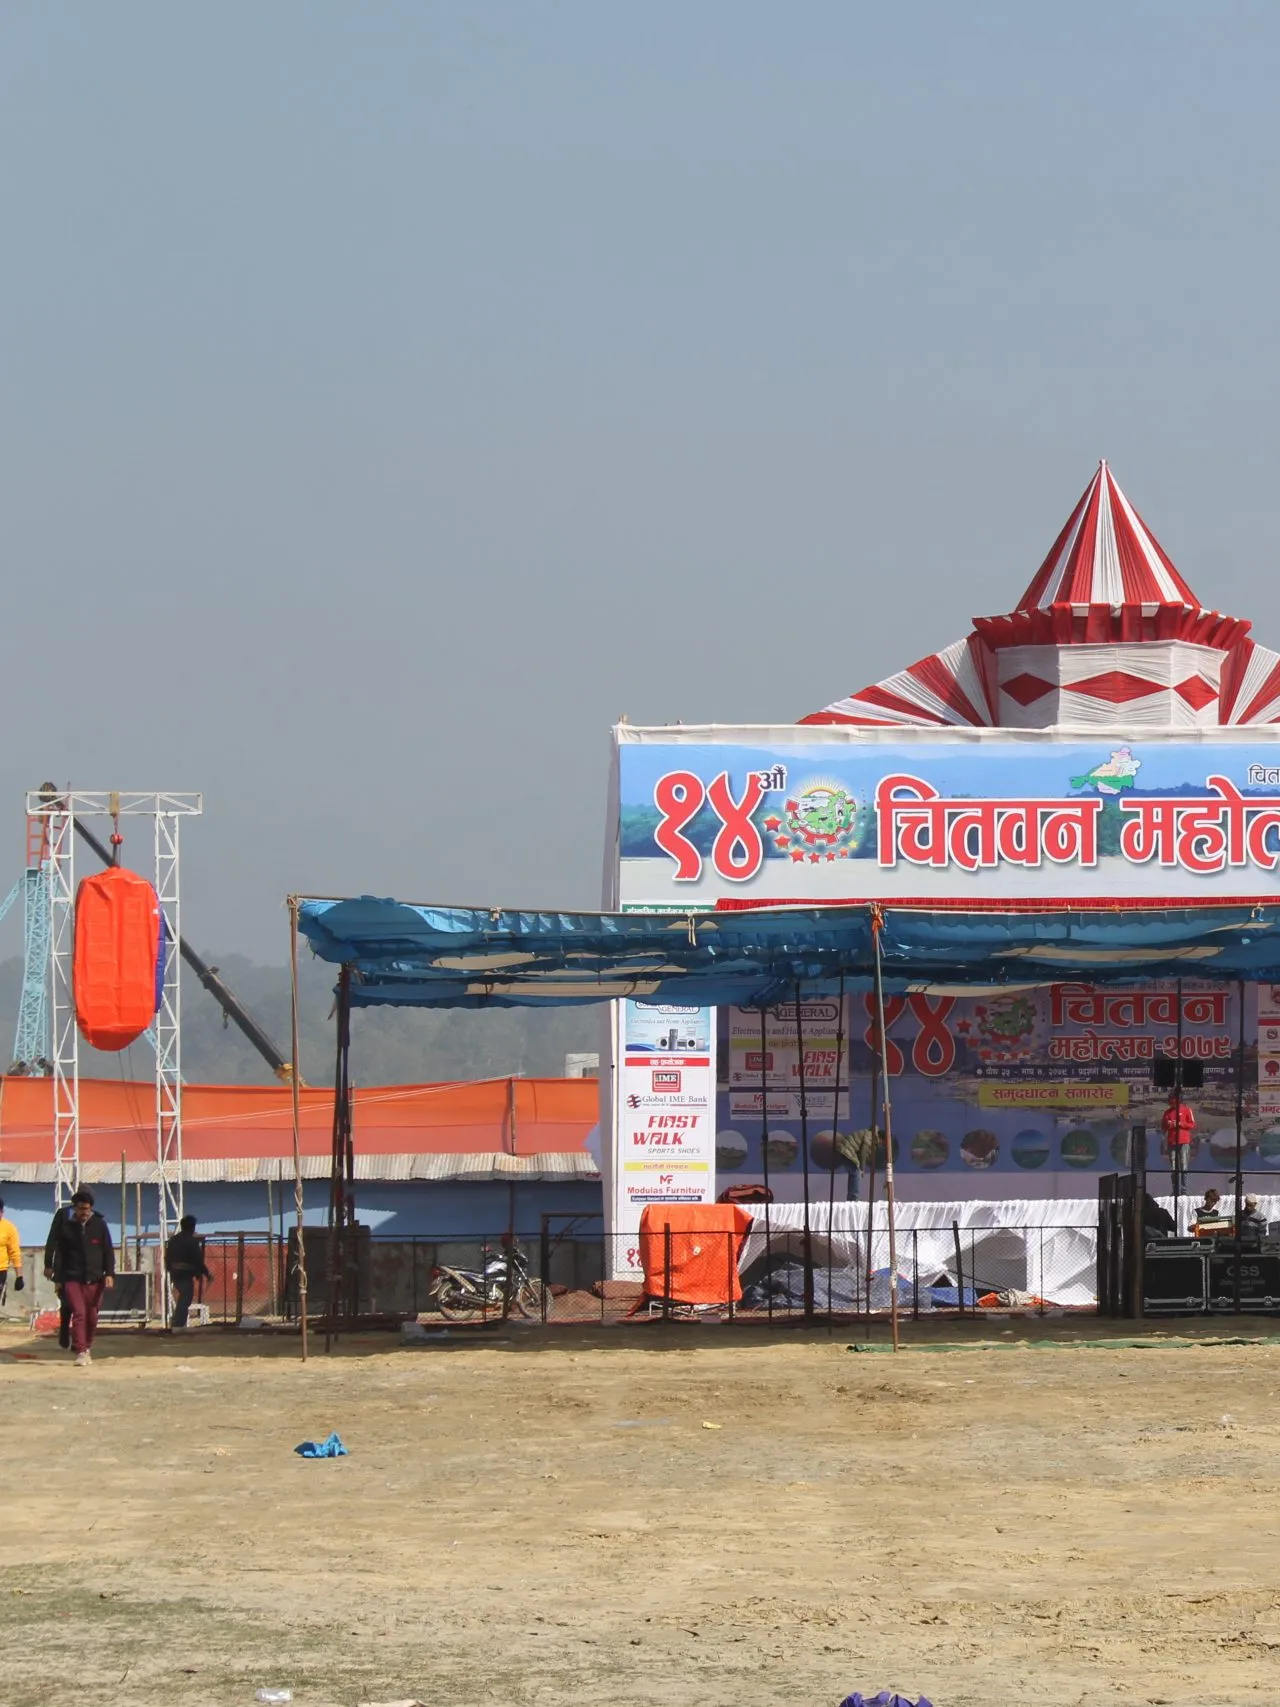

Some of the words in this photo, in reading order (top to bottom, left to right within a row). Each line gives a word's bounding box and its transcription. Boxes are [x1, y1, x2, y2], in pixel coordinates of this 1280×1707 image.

[655, 771, 763, 881] १४
[875, 773, 1102, 870] चितवन
[1050, 983, 1229, 1027] चितवन
[786, 1026, 805, 1035] Hoe
[642, 1095, 666, 1103] Global
[1064, 1086, 1114, 1099] समारोह
[647, 1115, 700, 1128] FIRST
[633, 1132, 684, 1145] WALK
